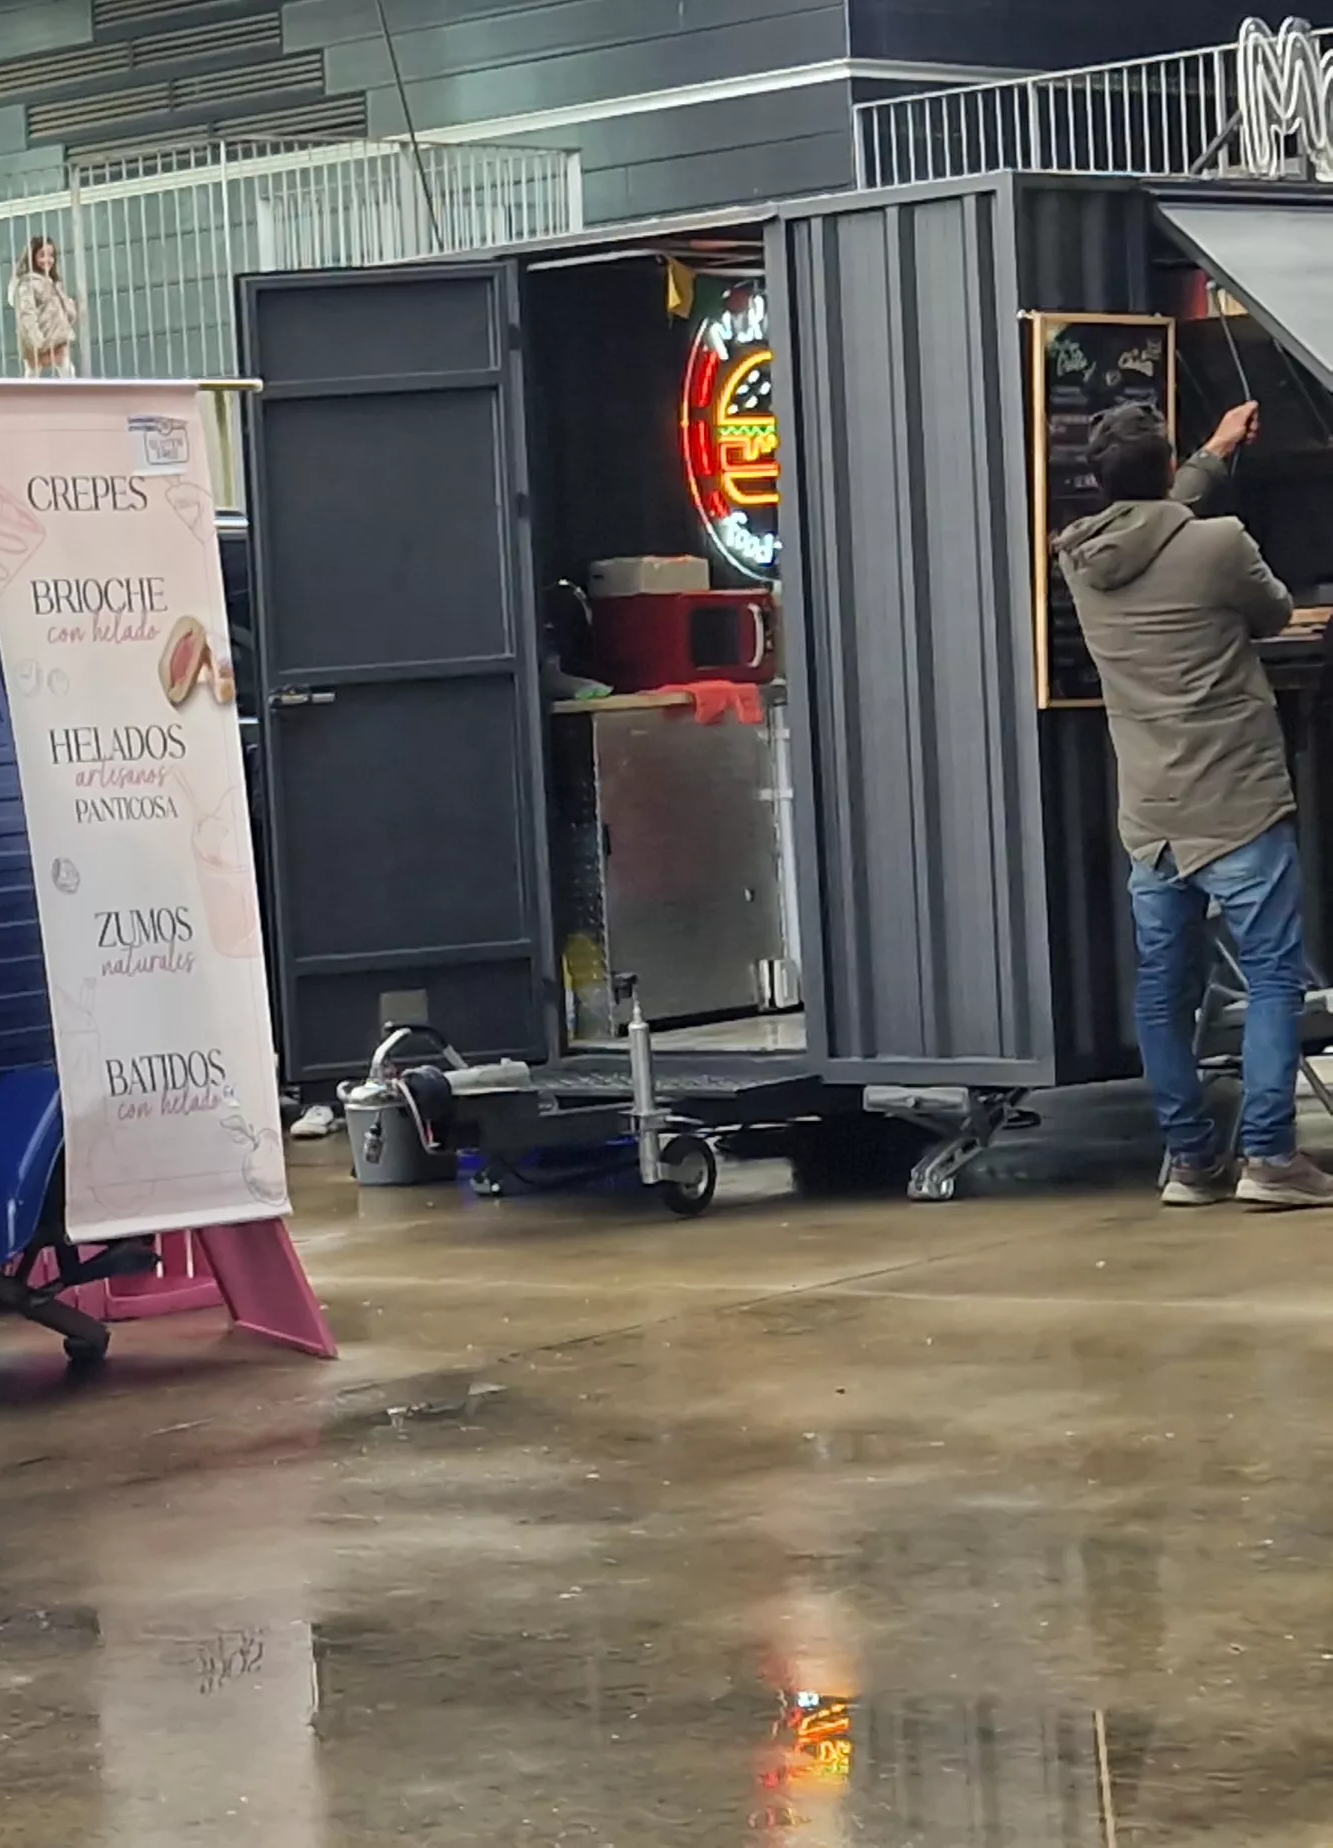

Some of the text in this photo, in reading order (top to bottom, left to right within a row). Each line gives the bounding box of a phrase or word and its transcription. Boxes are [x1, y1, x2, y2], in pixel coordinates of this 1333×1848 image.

[27, 475, 148, 512] CREPES
[31, 577, 168, 615] BRIOCHE
[47, 606, 160, 644] con helado
[48, 724, 187, 765] HELADOS
[75, 760, 166, 789] artesanos
[75, 796, 179, 824] PANTICOSA
[94, 906, 193, 948] ZUMOS
[101, 941, 196, 977] naturales
[105, 1048, 226, 1097] BATIDOS
[117, 1102, 152, 1121] con
[160, 1085, 222, 1117] helado
